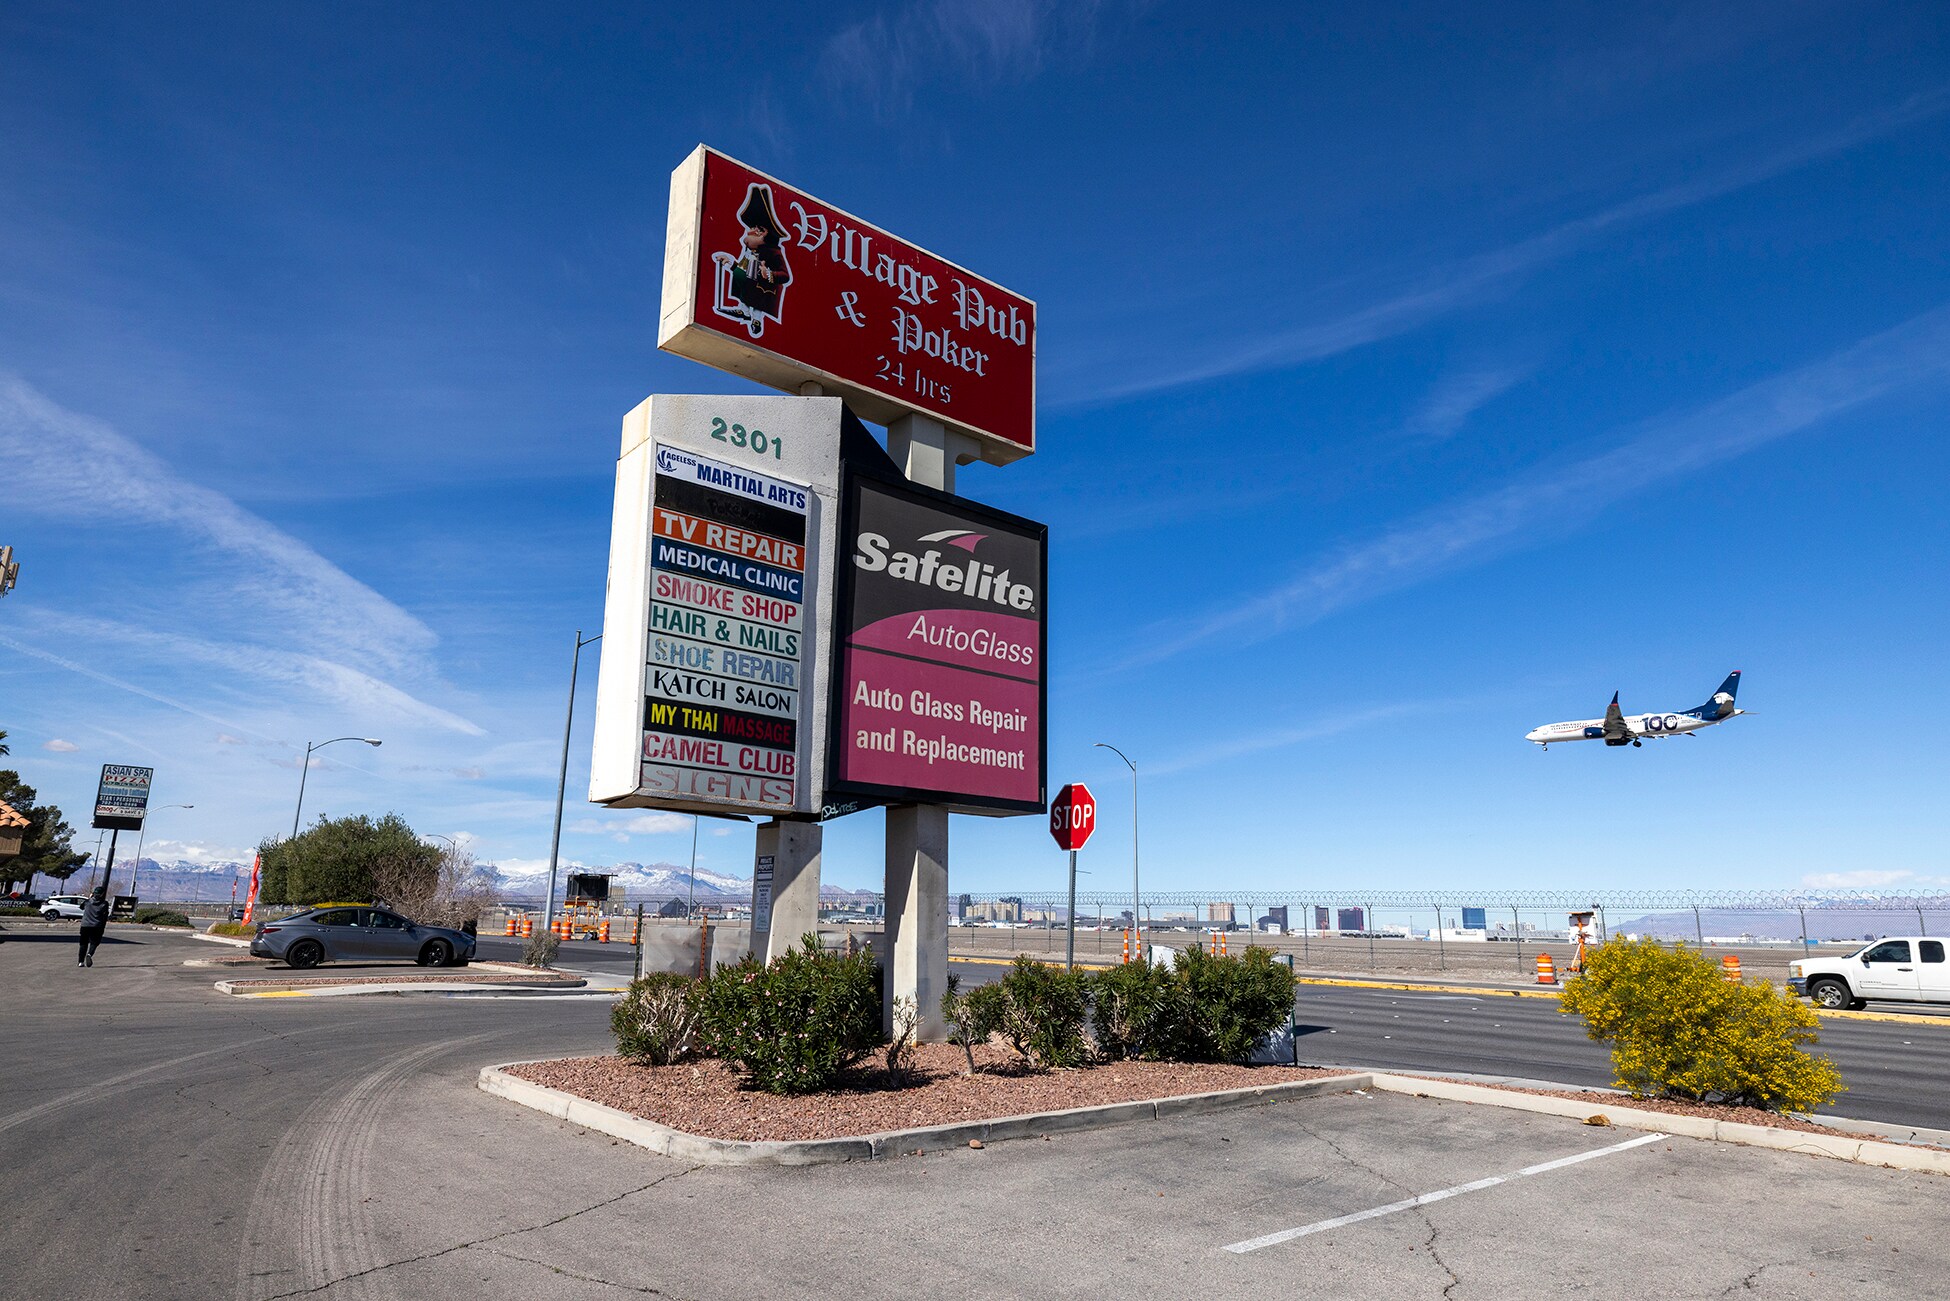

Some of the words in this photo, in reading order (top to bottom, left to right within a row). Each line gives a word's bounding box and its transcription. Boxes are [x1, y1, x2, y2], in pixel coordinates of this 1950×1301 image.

[790, 202, 939, 305] Village
[951, 278, 1027, 346] Pub
[835, 291, 866, 328] &
[891, 306, 989, 377] Poker
[875, 354, 905, 387] 24
[915, 369, 952, 404] hrs
[711, 417, 782, 460] 2301
[666, 451, 697, 467] AGELESS
[697, 463, 765, 498] MARTIAL
[768, 486, 806, 509] ARTS
[660, 512, 698, 540] TV
[706, 523, 798, 568] REPAIR
[658, 545, 742, 580] MEDICAL
[744, 567, 799, 595] CLINIC
[852, 532, 1034, 611] Safelite
[656, 575, 734, 612] SMOKE
[741, 594, 797, 624] SHOP
[652, 605, 706, 637] HAIR
[715, 620, 730, 642] &
[740, 624, 797, 656] NAILS
[907, 615, 1033, 665] AutoGlass
[654, 638, 714, 671] SHOE
[722, 650, 794, 686] REPAIR
[654, 670, 726, 701] KATCH
[735, 686, 791, 714] SALON
[853, 680, 903, 712] Auto
[909, 690, 964, 722] Glass
[969, 700, 1028, 734] Repair
[651, 703, 677, 726] MY
[682, 707, 718, 732] THAI
[723, 714, 792, 745] MASSAGE
[1642, 715, 1677, 732] 100
[106, 767, 131, 776] ASIAN
[134, 768, 149, 777] SPA
[643, 734, 729, 767] CAMEL
[738, 747, 795, 775] CLUB
[856, 728, 895, 753] and
[902, 730, 1025, 771] Replacement
[106, 776, 147, 784] PIZZA
[641, 763, 794, 804] SIGNS
[1053, 804, 1093, 830] STOP
